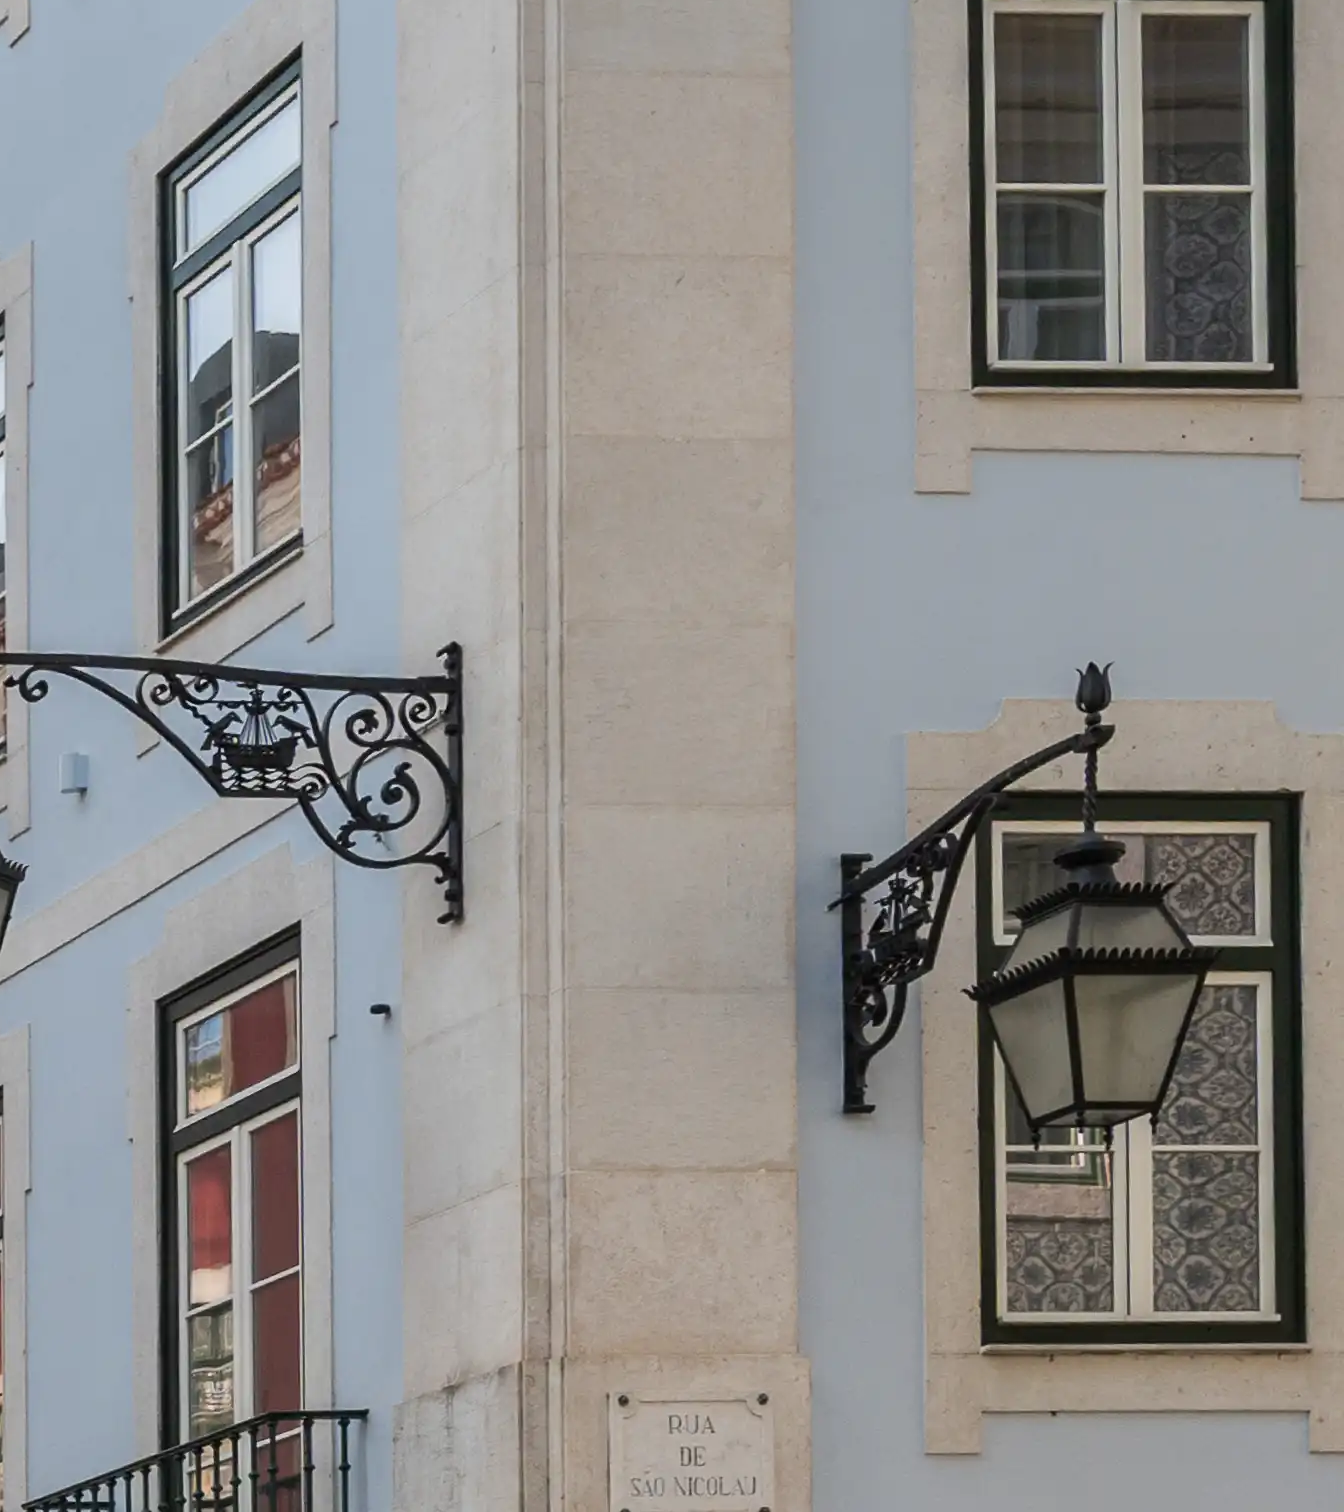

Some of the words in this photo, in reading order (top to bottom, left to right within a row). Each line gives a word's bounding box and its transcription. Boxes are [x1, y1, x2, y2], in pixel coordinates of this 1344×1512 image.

[668, 1414, 716, 1435] RUA
[680, 1445, 707, 1467] DE
[630, 1470, 665, 1497] SÃO
[673, 1476, 757, 1497] NICOLAU
